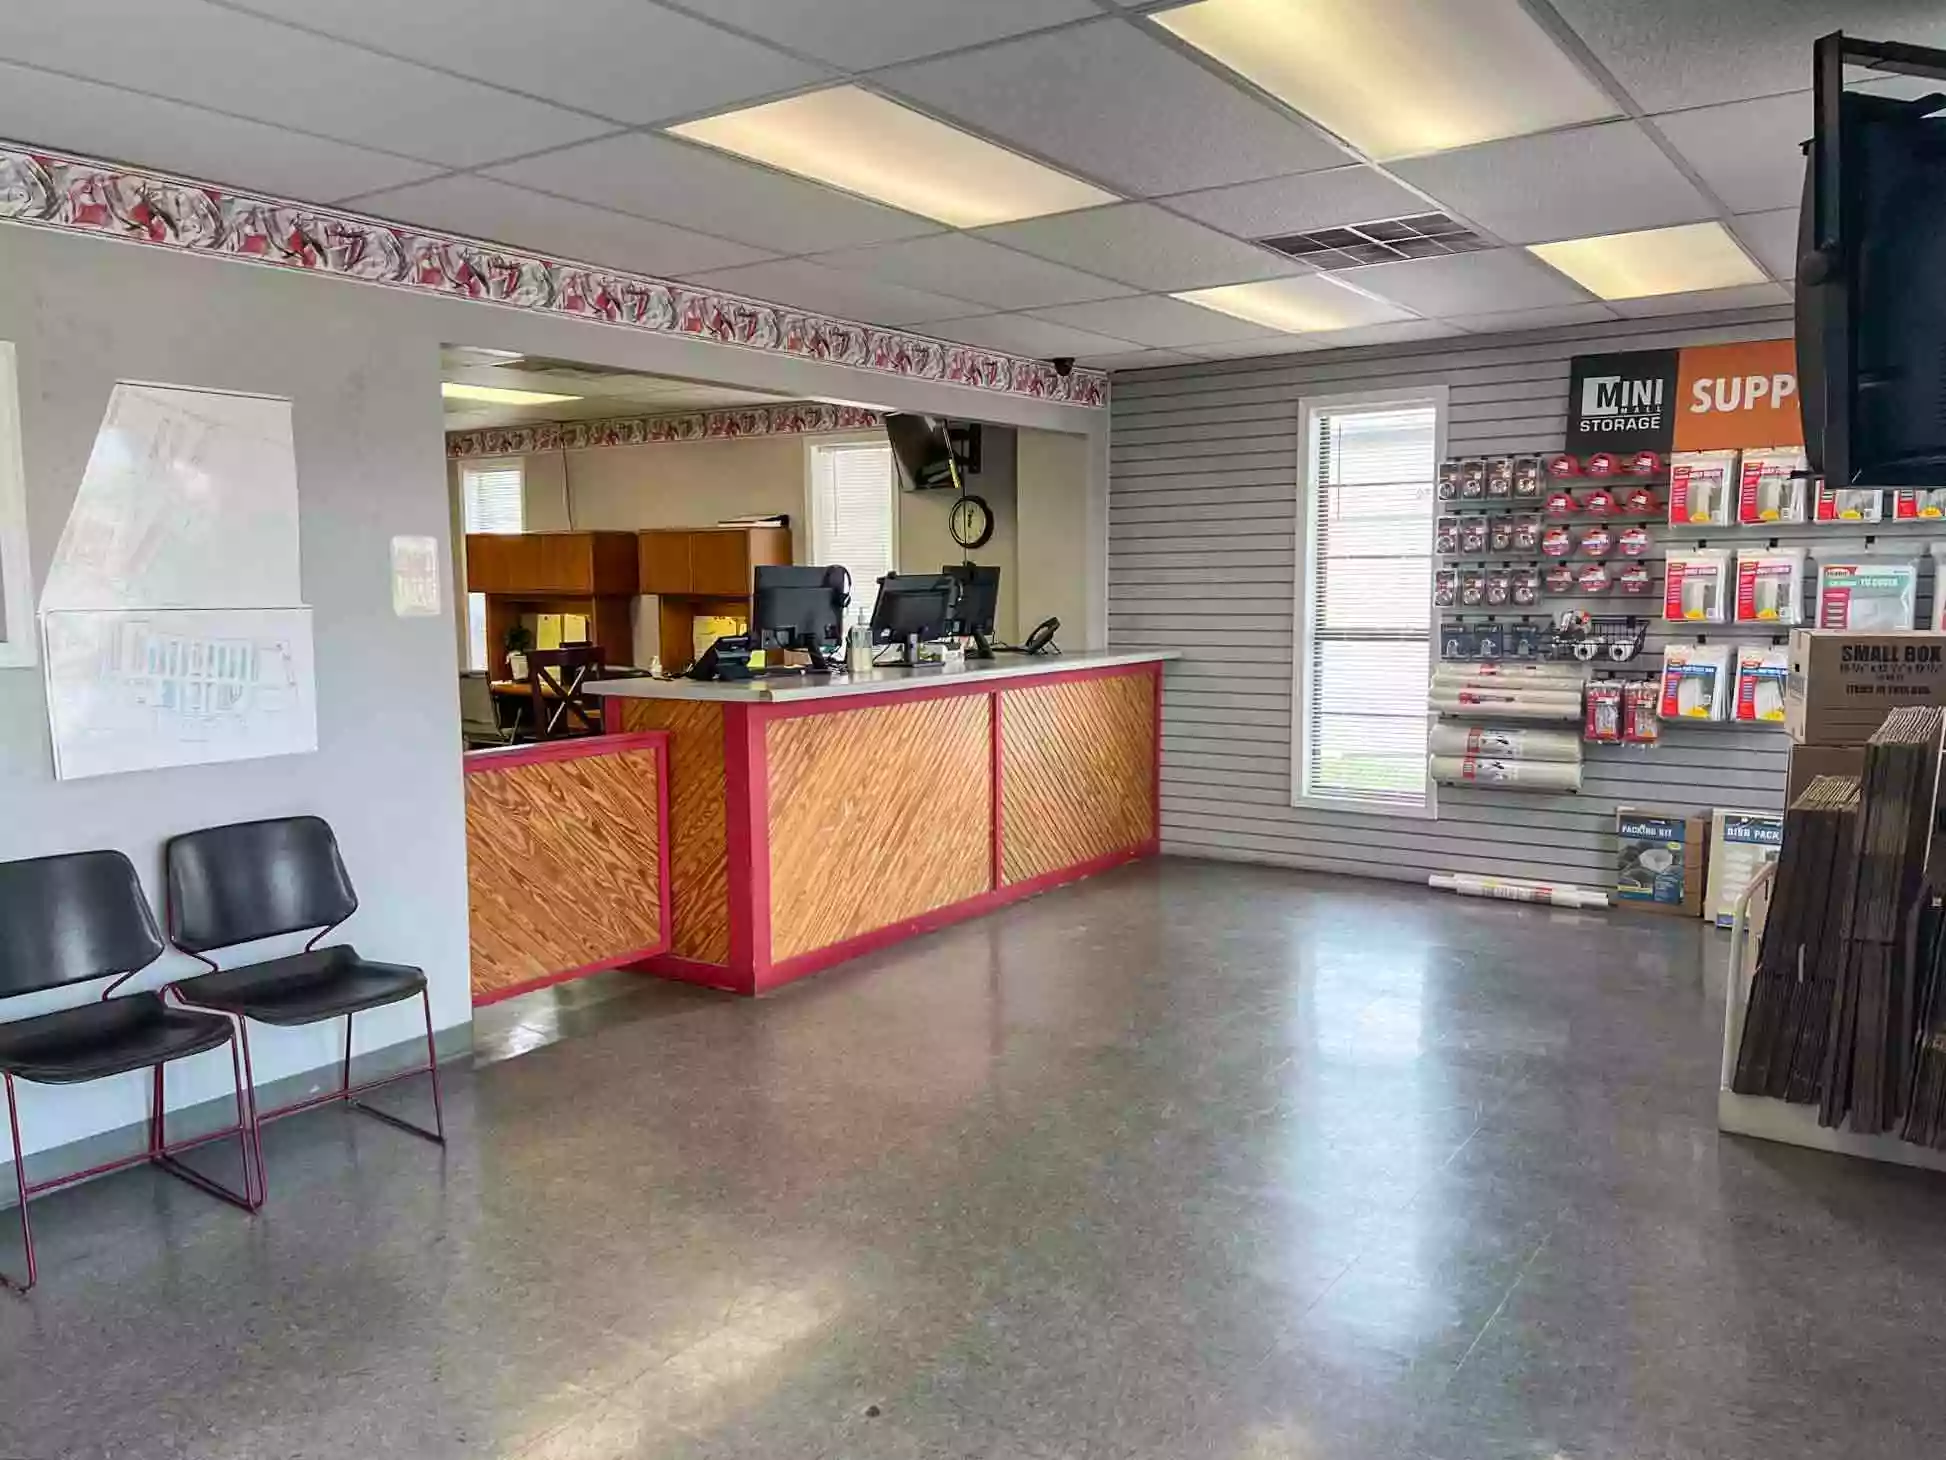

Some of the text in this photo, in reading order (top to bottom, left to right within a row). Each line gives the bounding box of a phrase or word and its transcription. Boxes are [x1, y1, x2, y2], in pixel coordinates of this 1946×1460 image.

[1594, 378, 1664, 409] MINI
[1689, 374, 1800, 413] SUPP
[1580, 416, 1661, 433] STORAGE
[1841, 645, 1943, 663] SMALL BOX
[1621, 823, 1672, 838] PACKING KIT
[1726, 826, 1781, 841] DISH PACK
